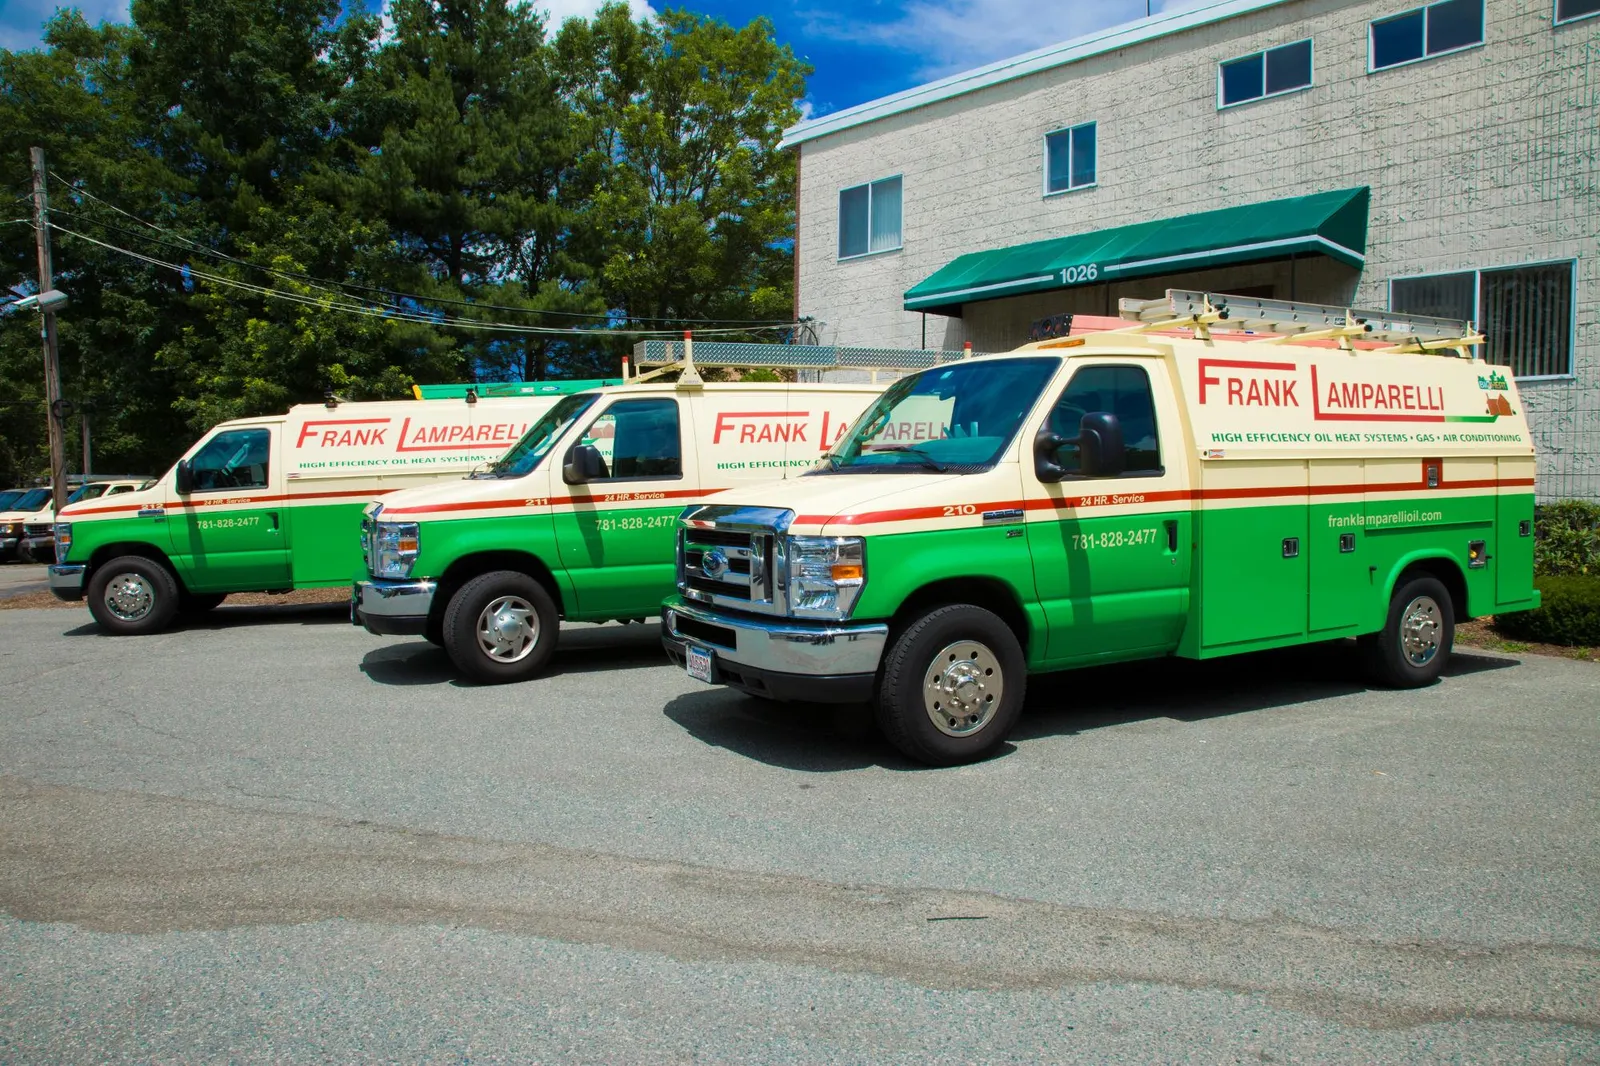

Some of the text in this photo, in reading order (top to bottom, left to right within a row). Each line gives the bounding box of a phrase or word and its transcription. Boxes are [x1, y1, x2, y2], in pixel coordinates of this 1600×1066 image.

[1060, 263, 1098, 284] 1026
[1198, 358, 1446, 423] FRANK LAMPARELLI
[296, 418, 391, 448] FRANK
[713, 411, 810, 444] FRANK
[1211, 432, 1521, 443] HIGH EFFICIENCY OIL HEAT SYSTEMS GAS AIR CONDITIONING
[299, 461, 326, 469] HIGH
[329, 459, 389, 468] EFFICIENCY
[391, 458, 409, 466] OIL
[411, 456, 437, 465] HEAT
[440, 454, 486, 463] SYSTEMS
[717, 461, 746, 470] HIGH
[749, 459, 811, 469] EFFICIENCY
[525, 498, 548, 506] 211
[604, 492, 665, 502] 24 HR. Service
[1080, 494, 1145, 507] 24 HR. Service
[943, 504, 976, 517] 210
[197, 517, 260, 530] 781-828-2477
[595, 515, 676, 531] 781-828-2477
[1328, 510, 1442, 528] franklamparellioil.com
[1072, 529, 1158, 550] 781-828-2477
